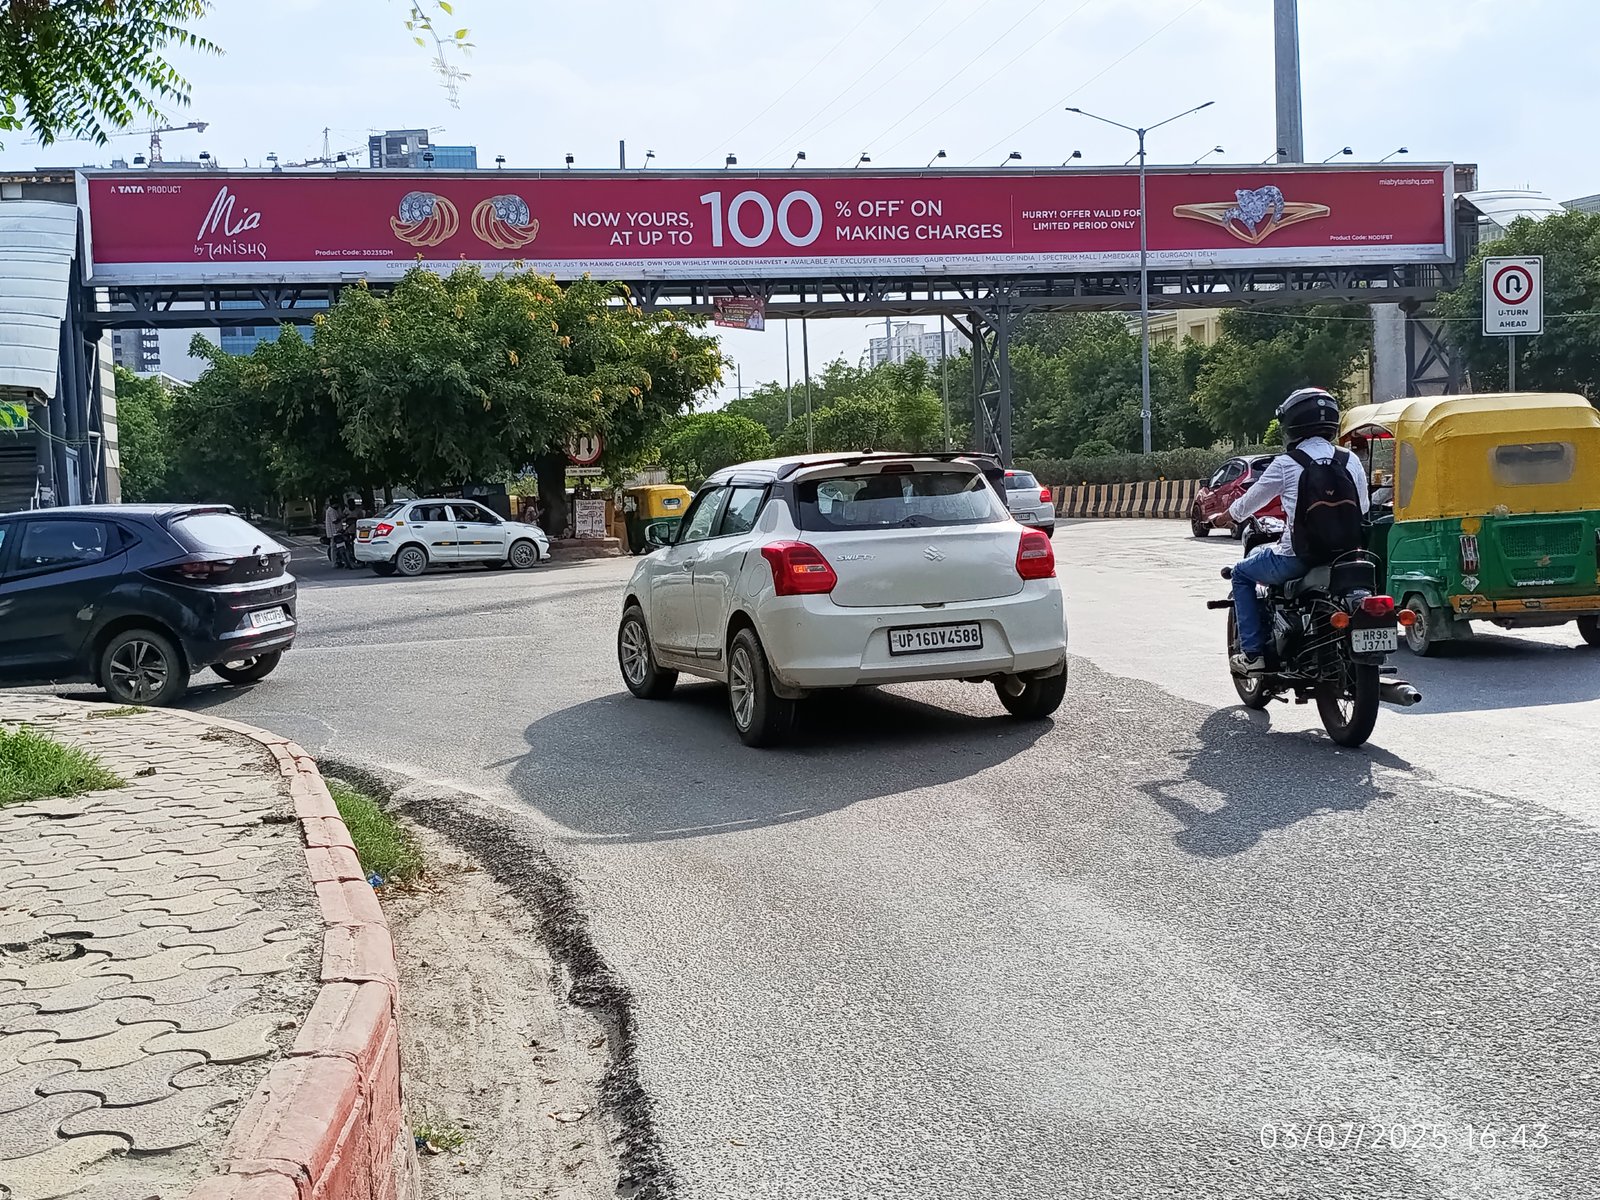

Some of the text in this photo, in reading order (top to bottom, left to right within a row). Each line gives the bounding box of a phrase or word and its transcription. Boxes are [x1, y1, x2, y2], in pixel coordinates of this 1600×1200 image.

[1379, 178, 1435, 187] miabytanishq.com
[197, 186, 261, 241] Mia
[834, 200, 852, 217] %
[911, 199, 942, 217] ON
[699, 190, 824, 248] 100
[1022, 209, 1142, 219] HURRY! OFFER VALID FOR
[573, 212, 694, 228] NOW YOURS,
[1033, 221, 1135, 230] LIMITED PERIOD ONLY
[836, 223, 1003, 240] MAKING CHARGES
[610, 230, 693, 246] AT UP TO
[193, 245, 204, 255] by
[1498, 309, 1529, 317] U-TURN
[1499, 320, 1527, 328] AHEAD
[898, 628, 979, 648] UP16DV4588
[1363, 630, 1388, 641] HR98
[1362, 640, 1392, 651] J3711
